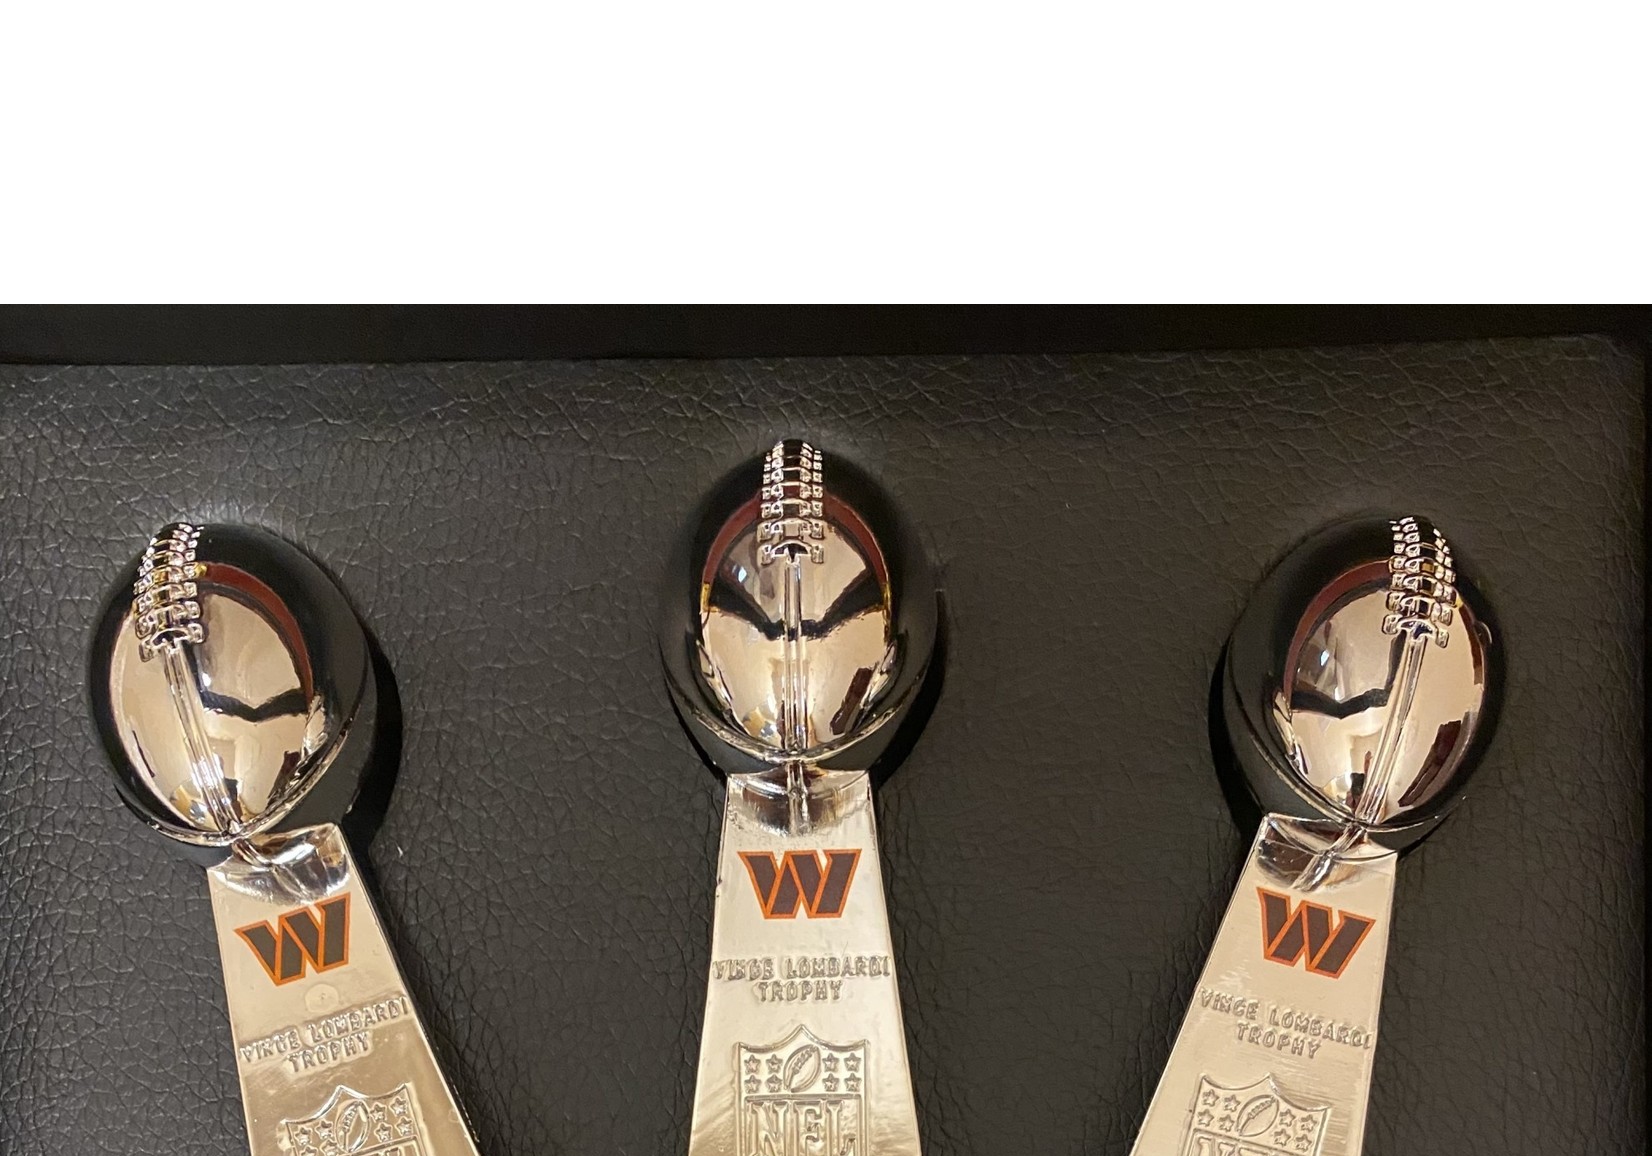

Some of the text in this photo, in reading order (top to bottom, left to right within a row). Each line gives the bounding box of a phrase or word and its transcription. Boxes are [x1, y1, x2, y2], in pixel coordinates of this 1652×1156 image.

[737, 849, 862, 919] W
[234, 891, 351, 986] W
[1256, 887, 1376, 979] W
[759, 980, 843, 1002] TROPHY
[1199, 987, 1372, 1049] VINCE LOMBARDI
[1237, 1019, 1322, 1059] TROPHY
